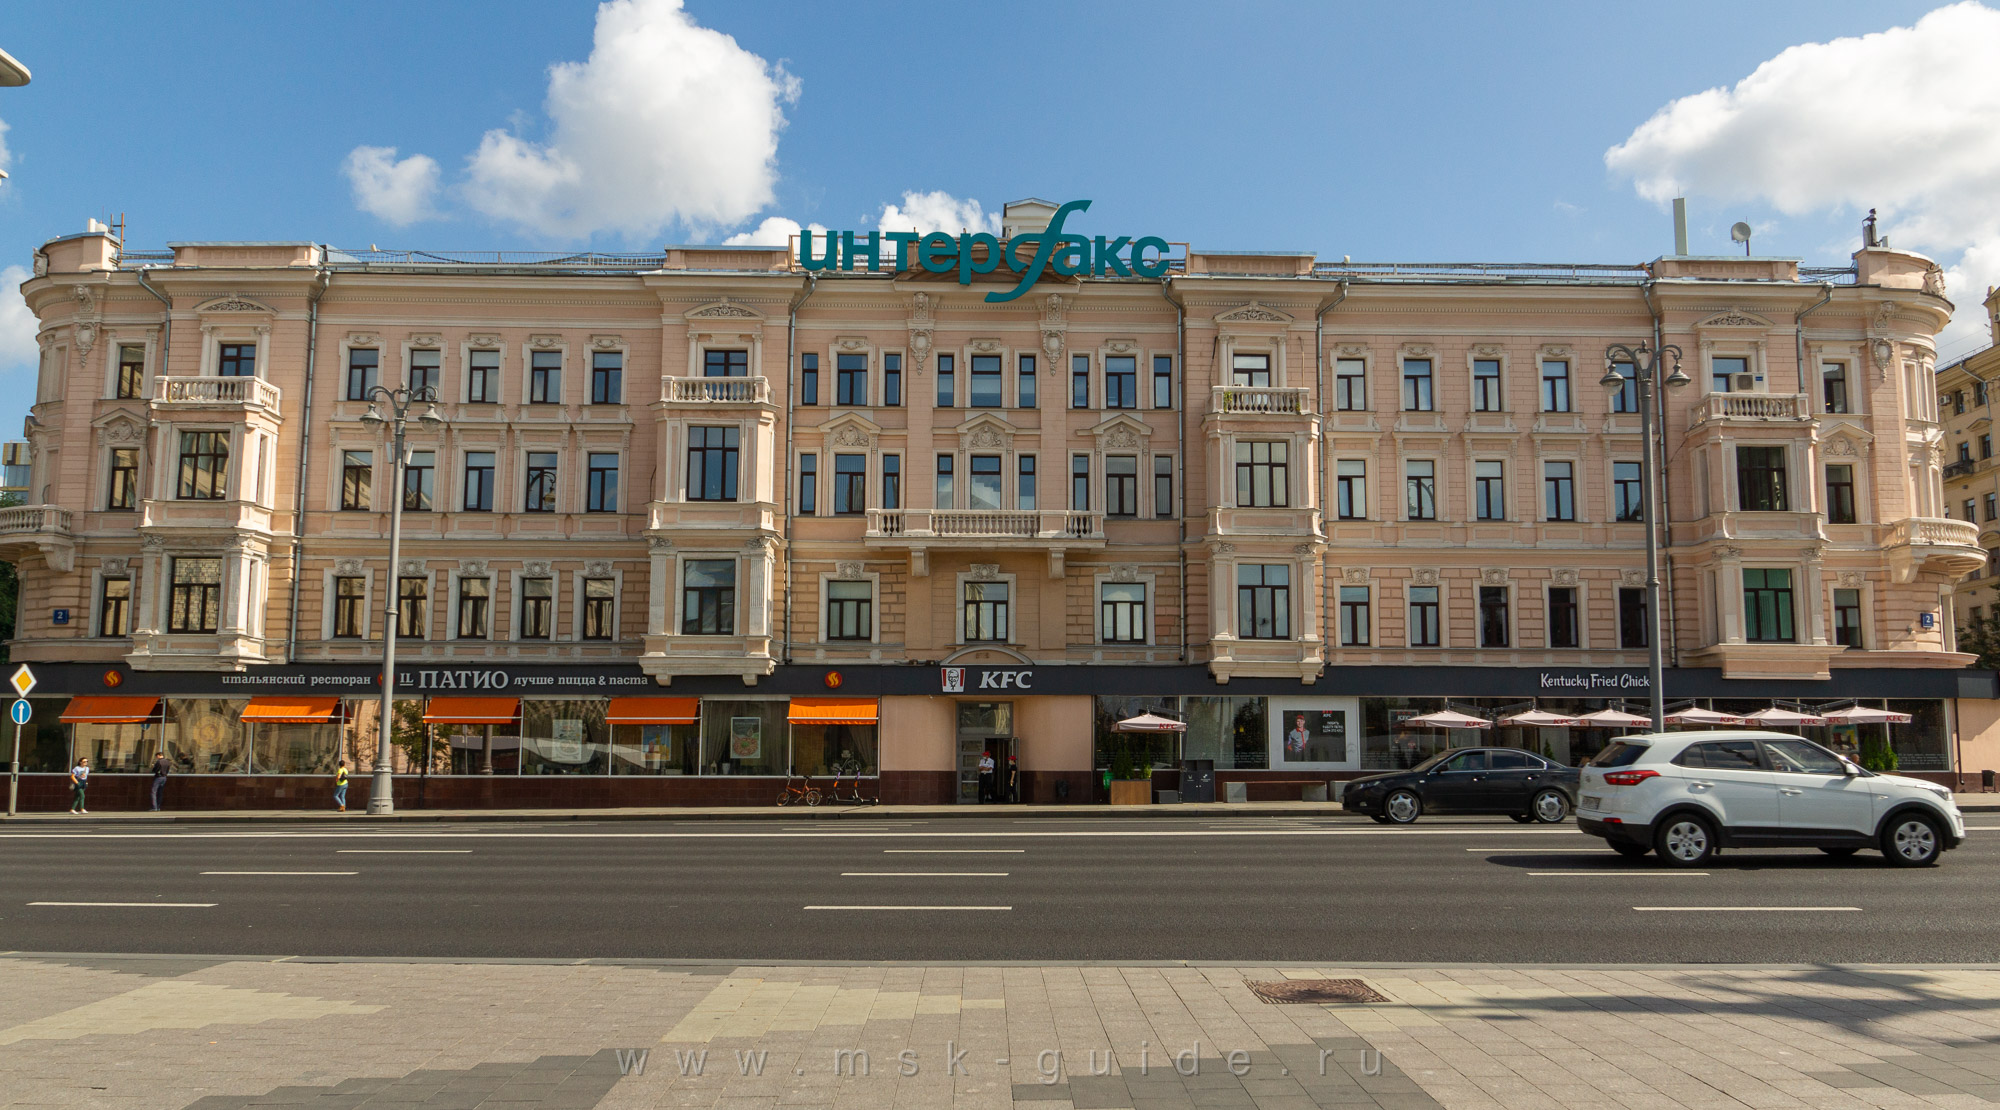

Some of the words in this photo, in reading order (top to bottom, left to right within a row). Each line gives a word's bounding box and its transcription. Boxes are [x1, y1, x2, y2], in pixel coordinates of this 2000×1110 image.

[800, 199, 1170, 303] интерфакс
[57, 611, 63, 619] 2
[1926, 615, 1931, 623] 2
[221, 674, 306, 684] итальянский
[310, 676, 371, 687] ресторан
[418, 670, 509, 689] ПАТИО
[514, 676, 554, 687] лучше
[557, 676, 597, 687] пицца
[598, 675, 606, 686] &
[609, 676, 648, 686] паста
[978, 671, 1033, 689] KFC
[1540, 672, 1589, 690] Kentucky
[1590, 673, 1618, 688] Fried
[1620, 673, 1651, 689] Chick
